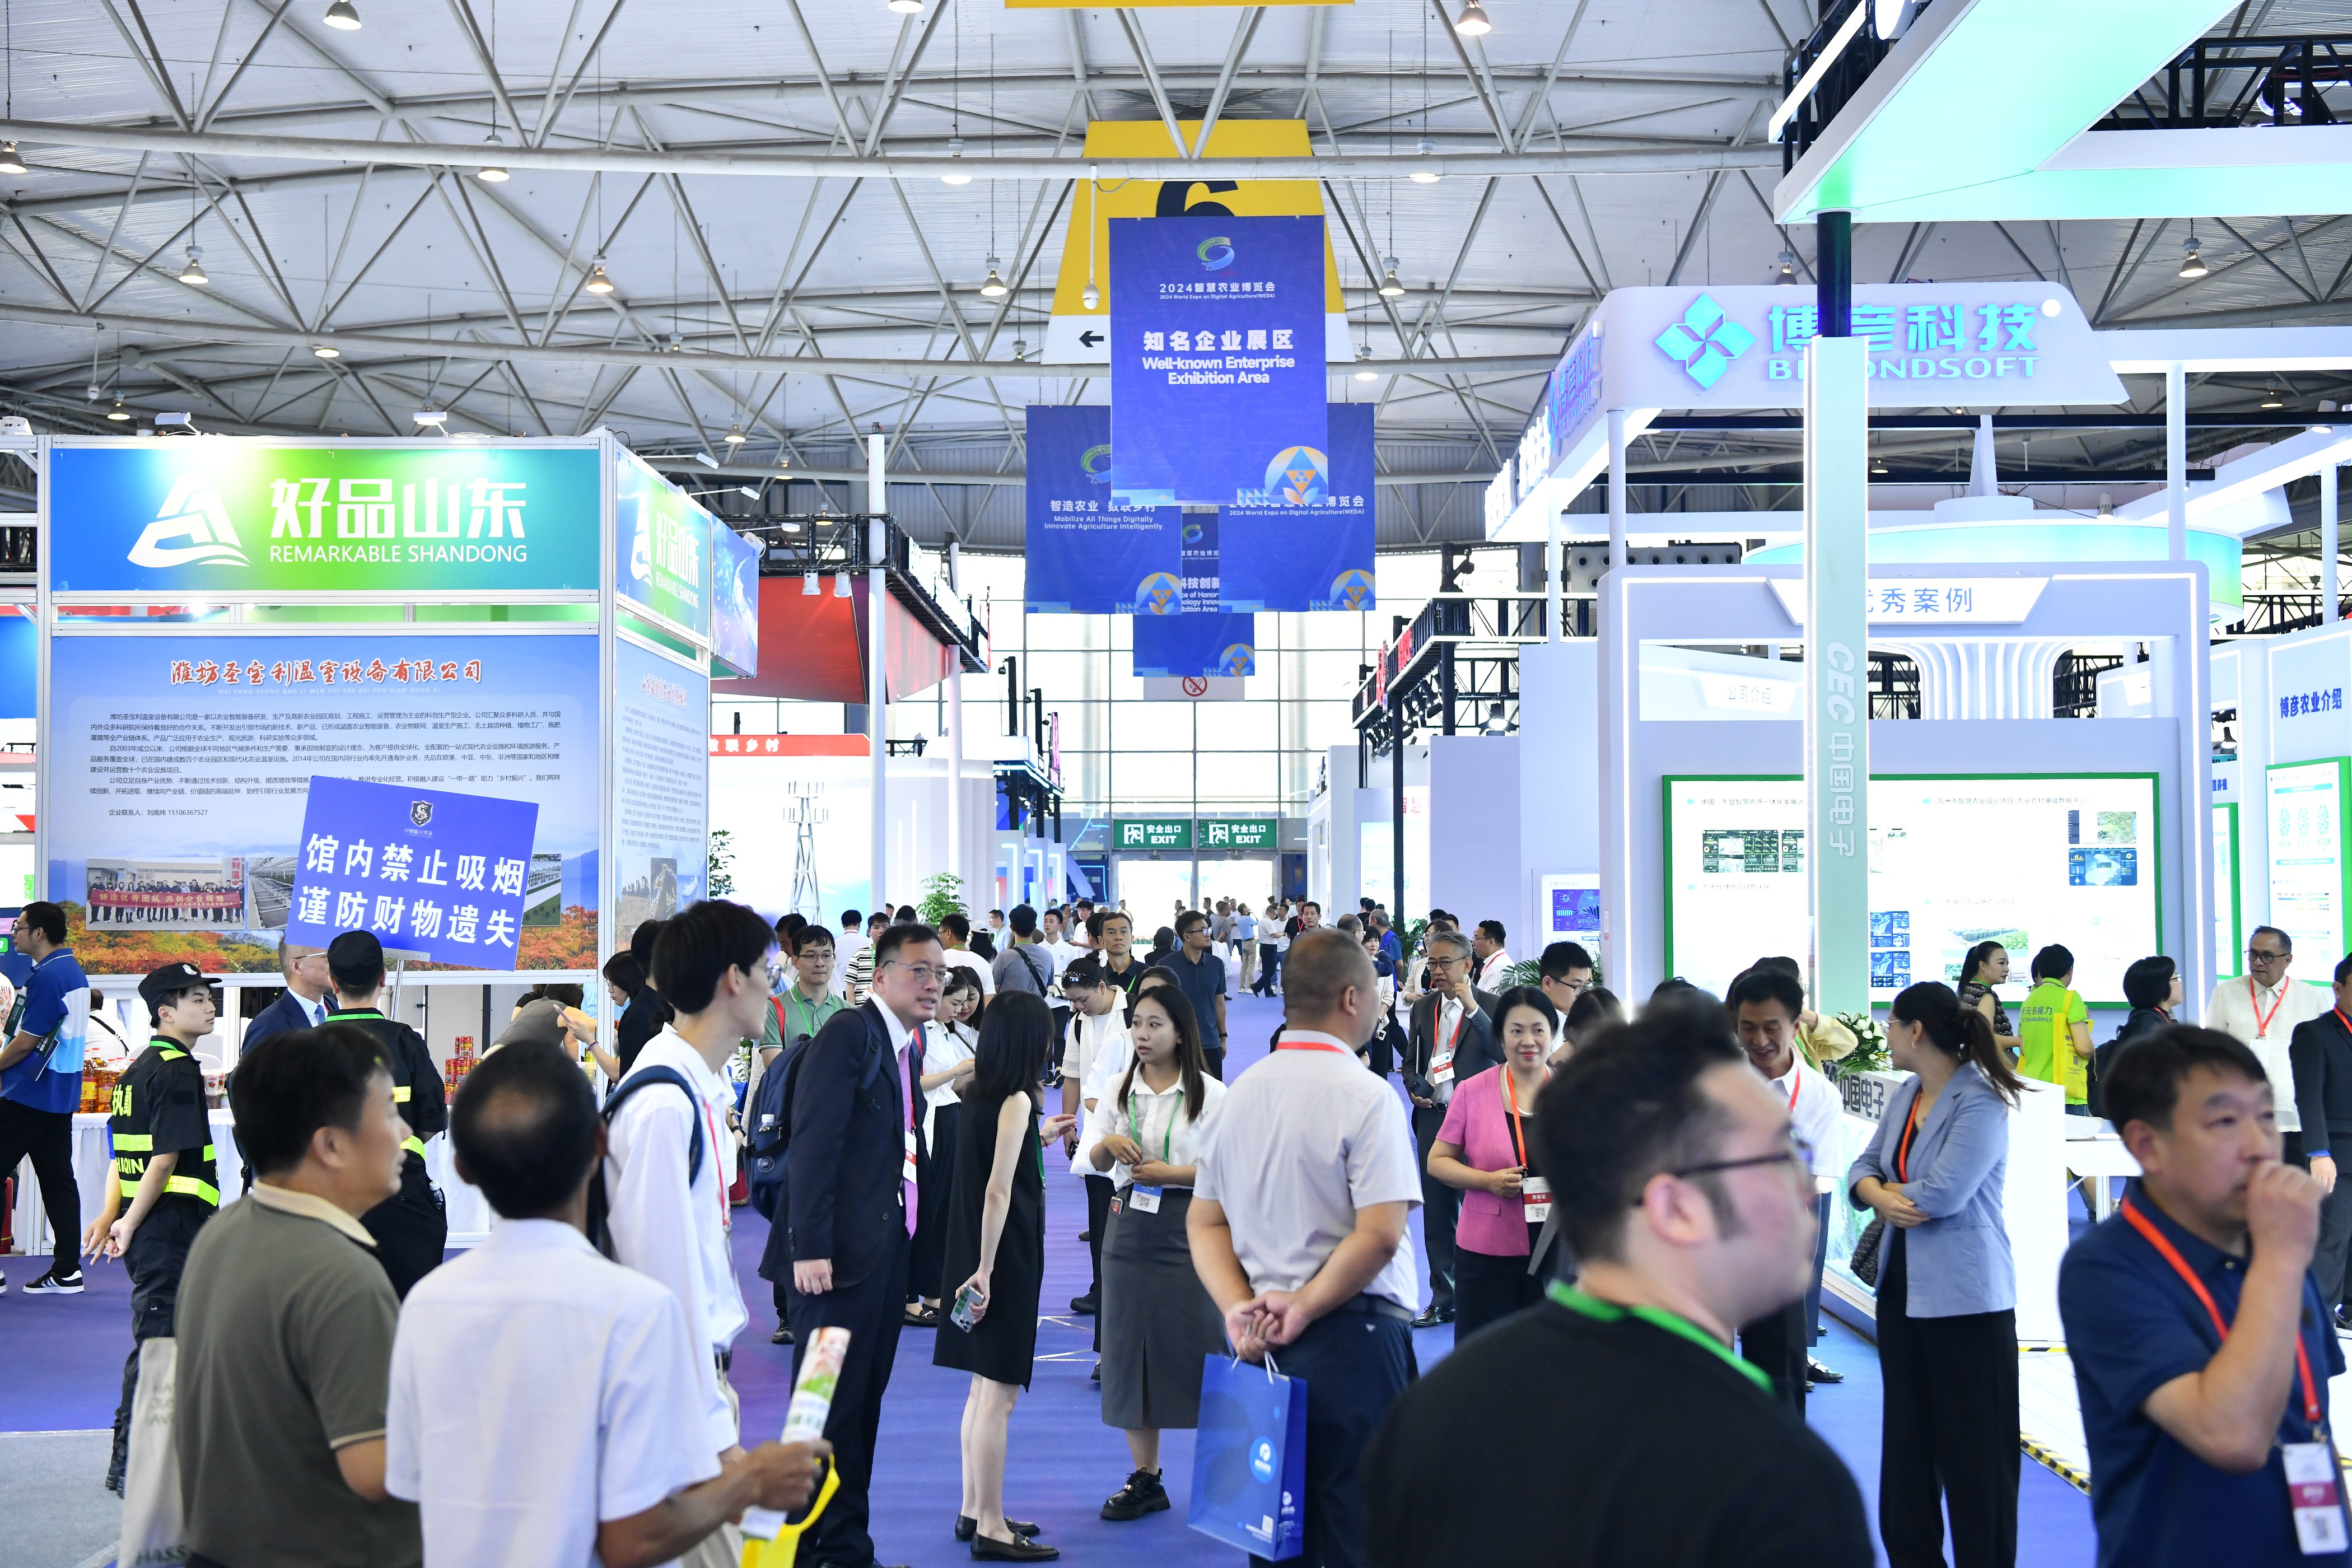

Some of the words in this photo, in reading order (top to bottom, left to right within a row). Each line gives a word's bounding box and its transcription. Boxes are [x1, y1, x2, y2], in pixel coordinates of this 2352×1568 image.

[1159, 282, 1275, 293] 2024智慧农业博览会
[1143, 329, 1294, 352] 知名企业展区
[1142, 357, 1222, 370] Well-known
[1225, 354, 1295, 371] Enterprise
[1768, 357, 2040, 380] BNDSOFT
[1168, 371, 1234, 385] Exhibition
[1237, 371, 1270, 384] Area
[269, 476, 526, 539] 好品山东
[1050, 500, 1099, 512] 智造农业
[269, 544, 401, 563] REMARKABLE
[408, 544, 527, 563] SHANDONG
[656, 510, 699, 589] 好品山东
[656, 571, 679, 598] REMARKABLE
[679, 585, 699, 609] SHANDONG
[1868, 587, 1972, 614] 秀案例
[171, 657, 482, 687] 潍坊圣宝利温室设备有限公司
[1827, 641, 1855, 725] CEC
[1728, 684, 1771, 705] 公司介绍
[2279, 687, 2342, 719] 博彦农业介绍
[1827, 732, 1855, 857] 中国电子
[1146, 824, 1182, 833] 安全出口
[1151, 835, 1177, 844] EXIT
[1231, 824, 1266, 833] 安全出口
[1235, 835, 1261, 844] EXIT
[305, 833, 526, 897] 馆内禁止吸烟
[297, 885, 515, 948] 谨防财物遗失
[113, 1084, 133, 1117] 执勤
